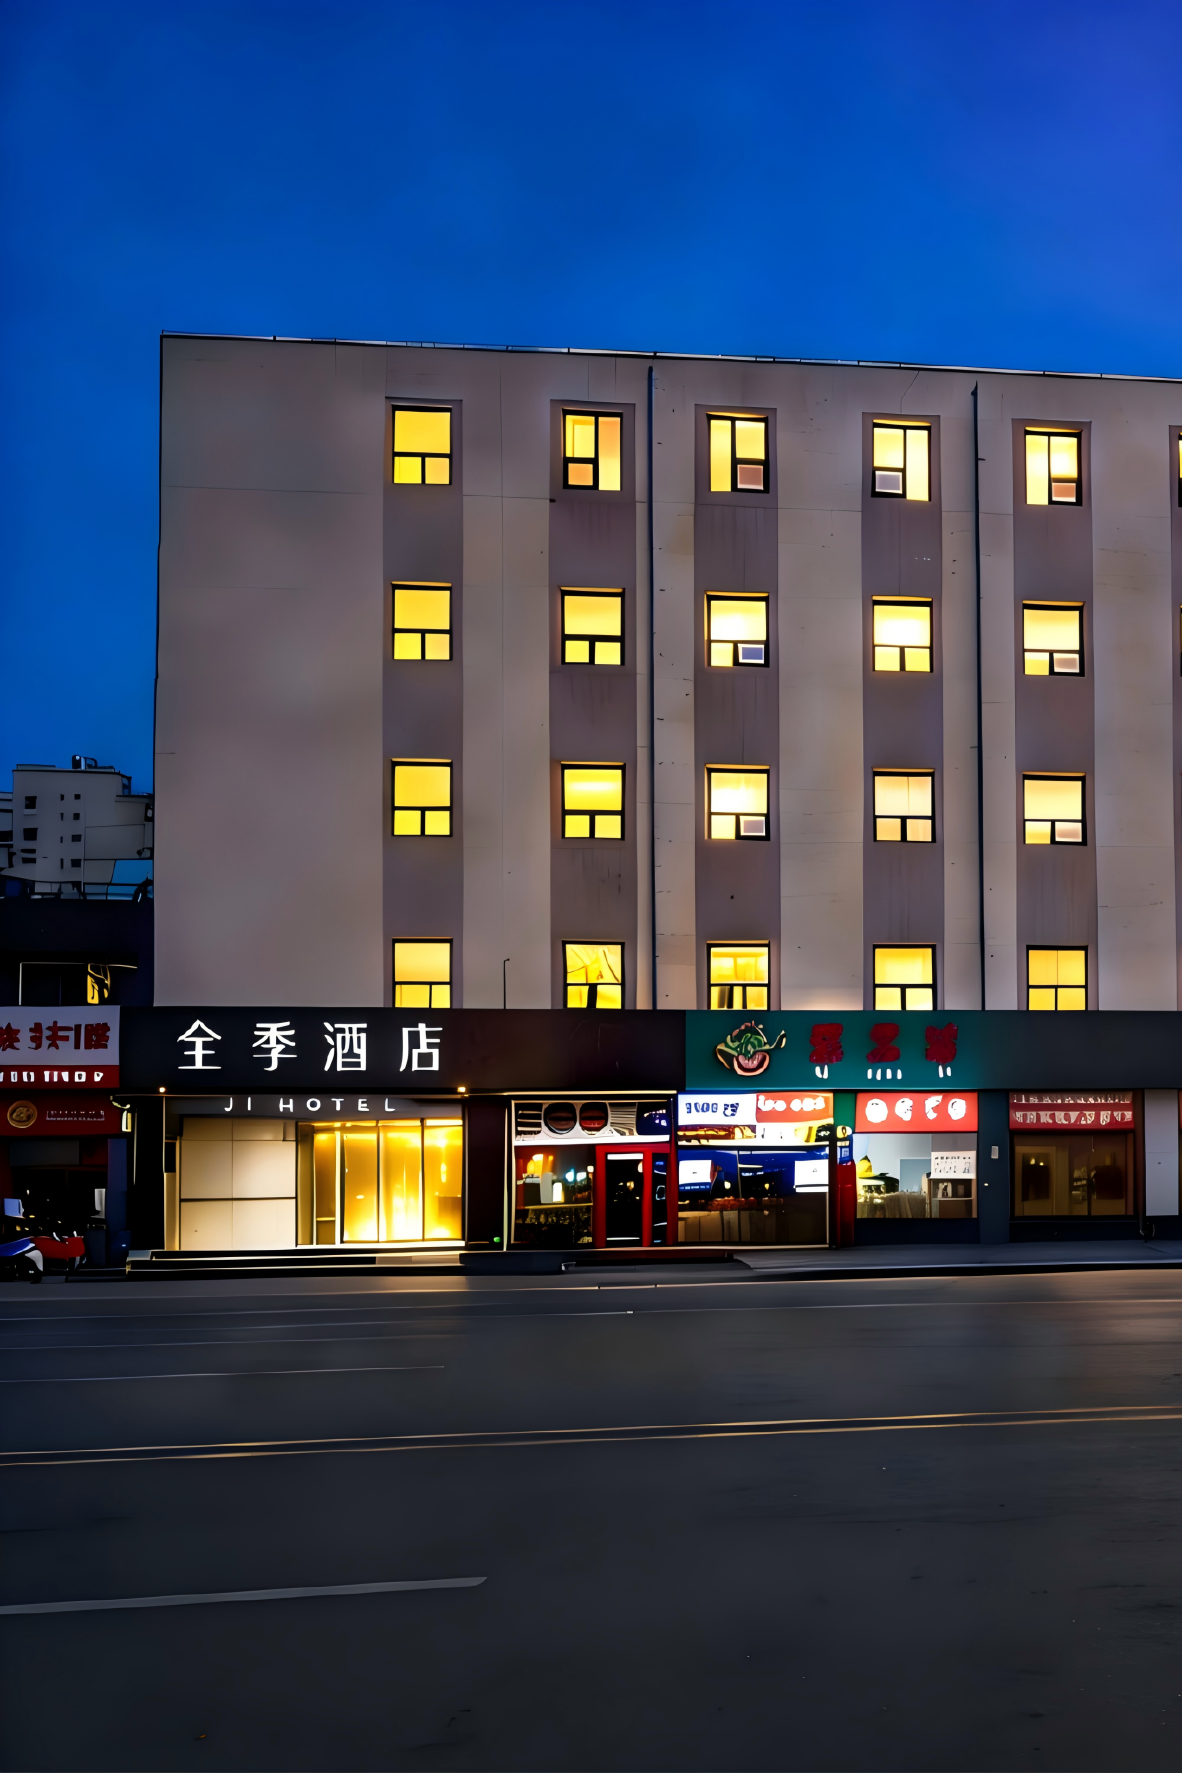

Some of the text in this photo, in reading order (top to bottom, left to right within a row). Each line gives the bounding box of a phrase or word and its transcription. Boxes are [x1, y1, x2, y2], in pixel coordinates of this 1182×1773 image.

[176, 1019, 443, 1072] 全季酒店
[224, 1096, 396, 1113] JI HOTEL
